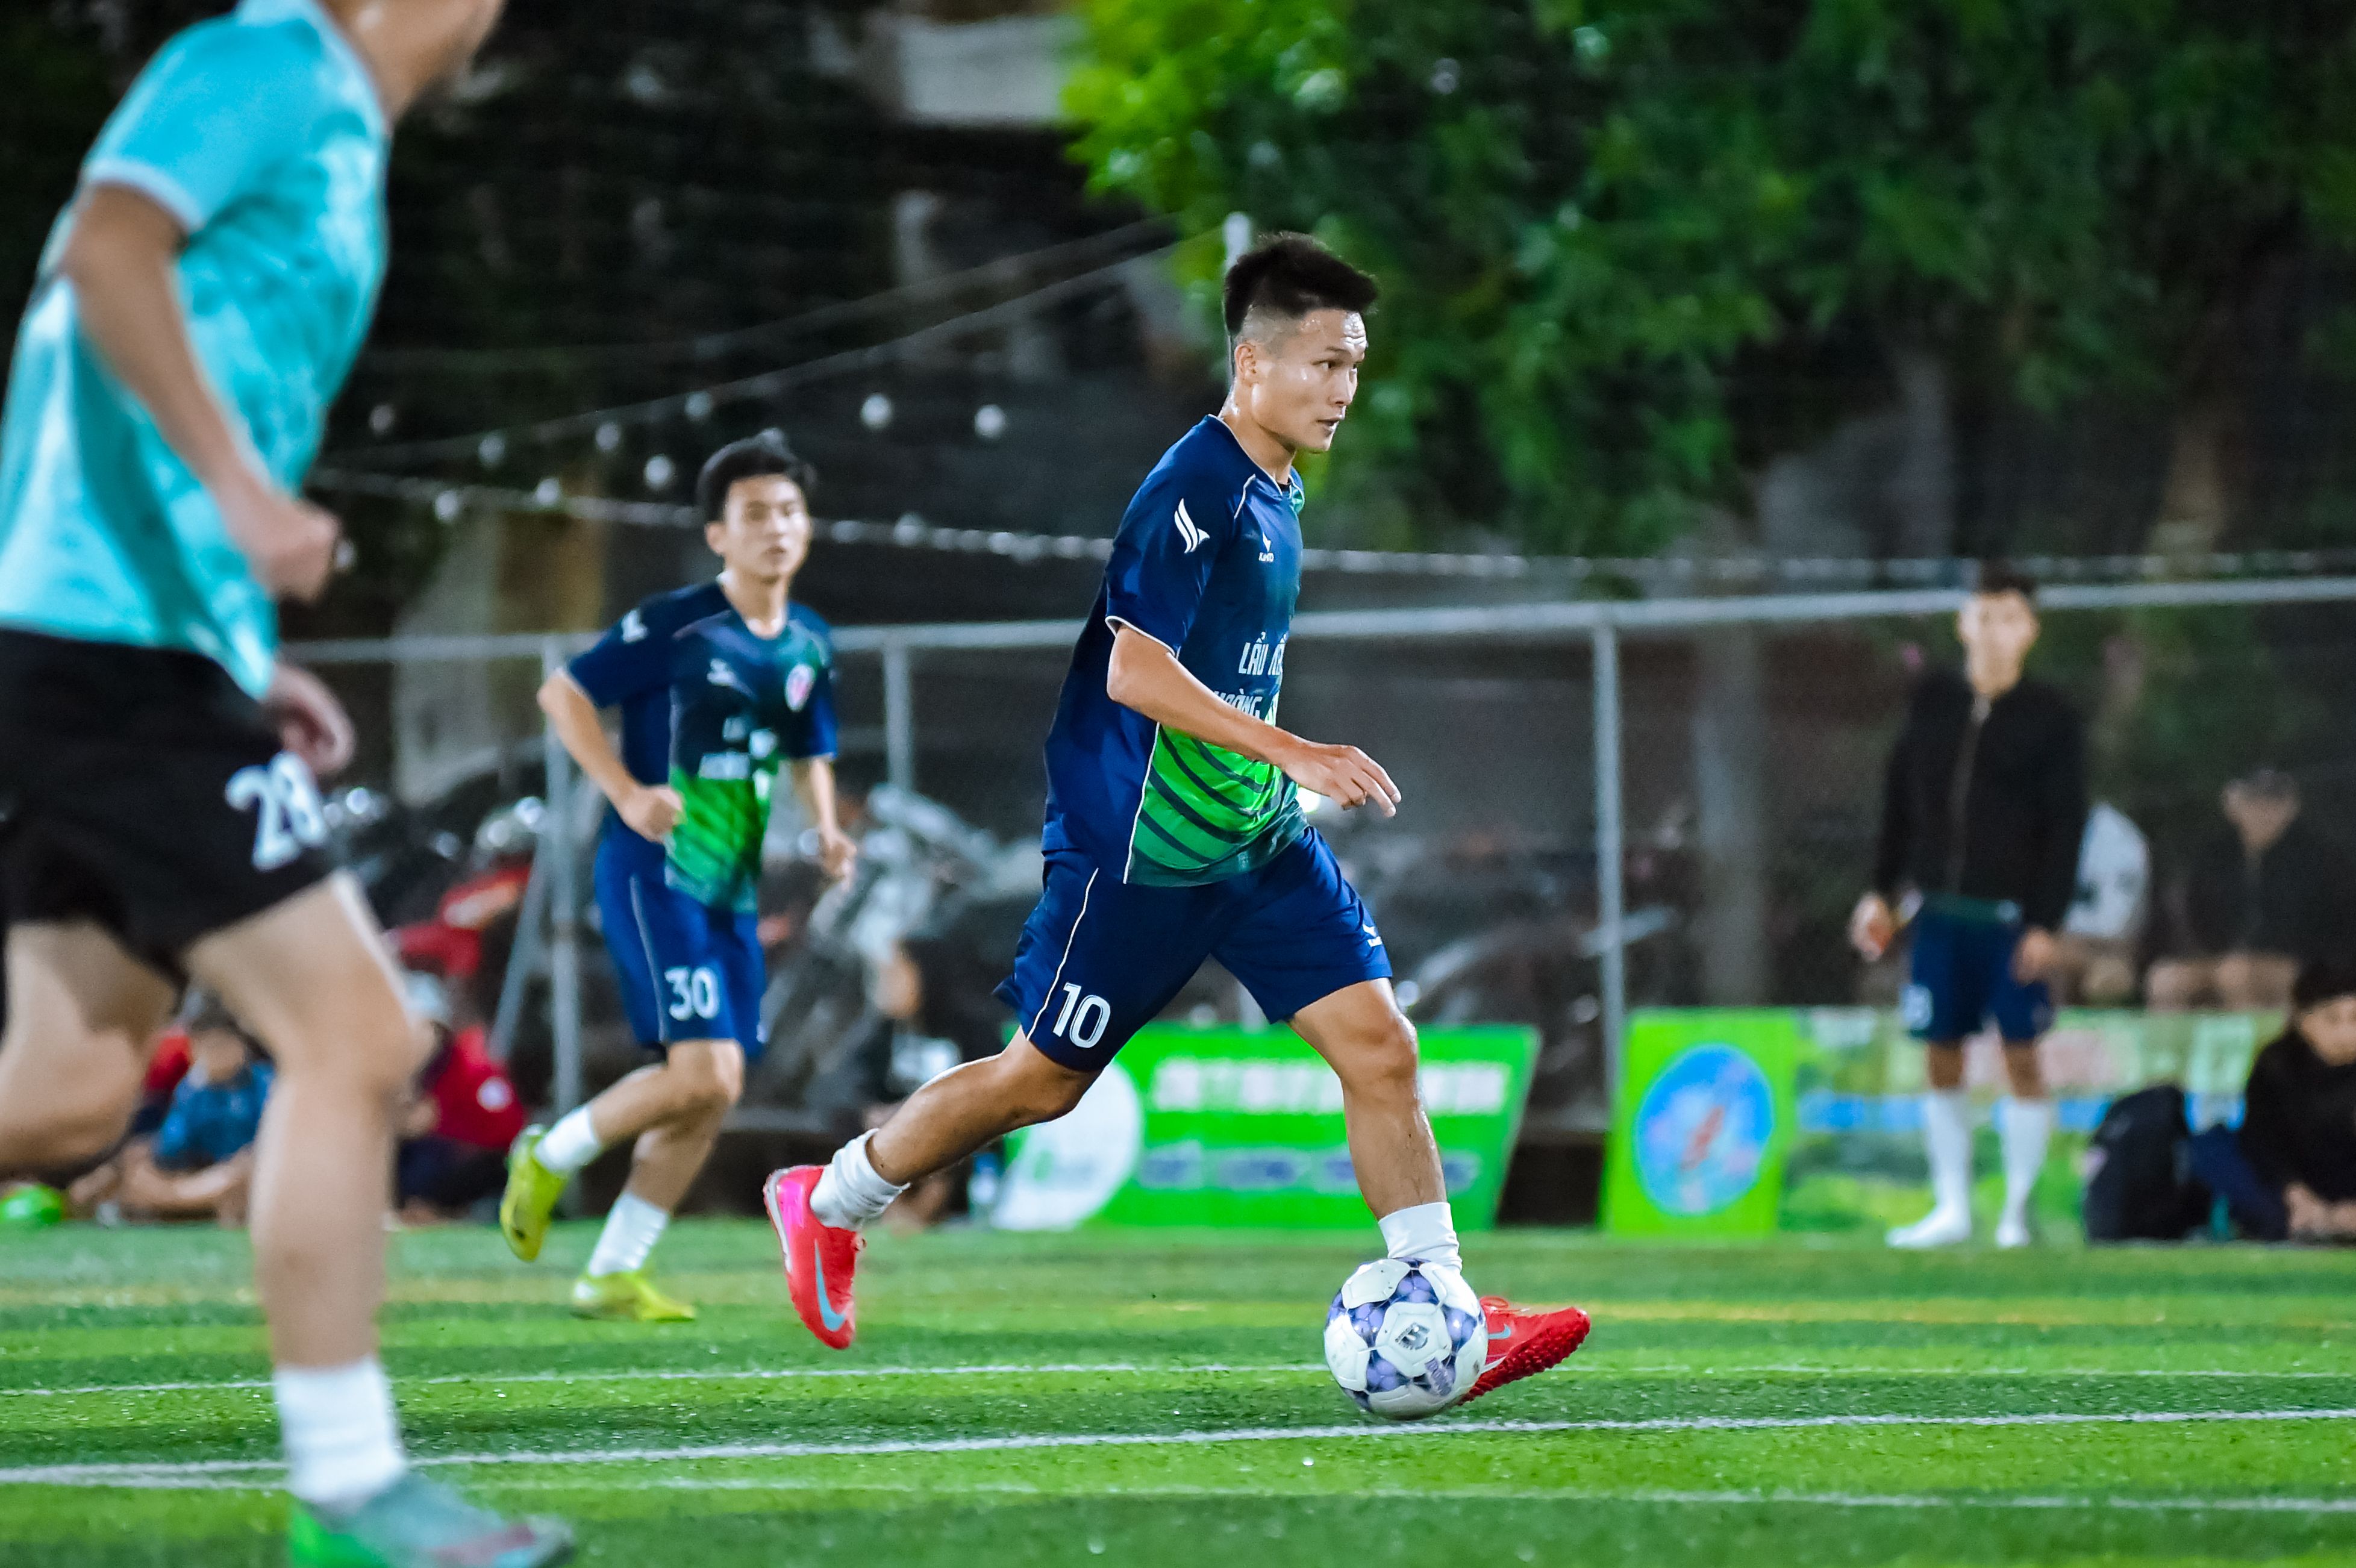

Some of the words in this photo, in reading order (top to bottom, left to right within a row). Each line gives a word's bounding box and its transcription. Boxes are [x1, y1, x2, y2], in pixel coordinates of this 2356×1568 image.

[1238, 631, 1269, 676] LẨU
[664, 966, 720, 1022] 30
[1052, 982, 1111, 1049] 10
